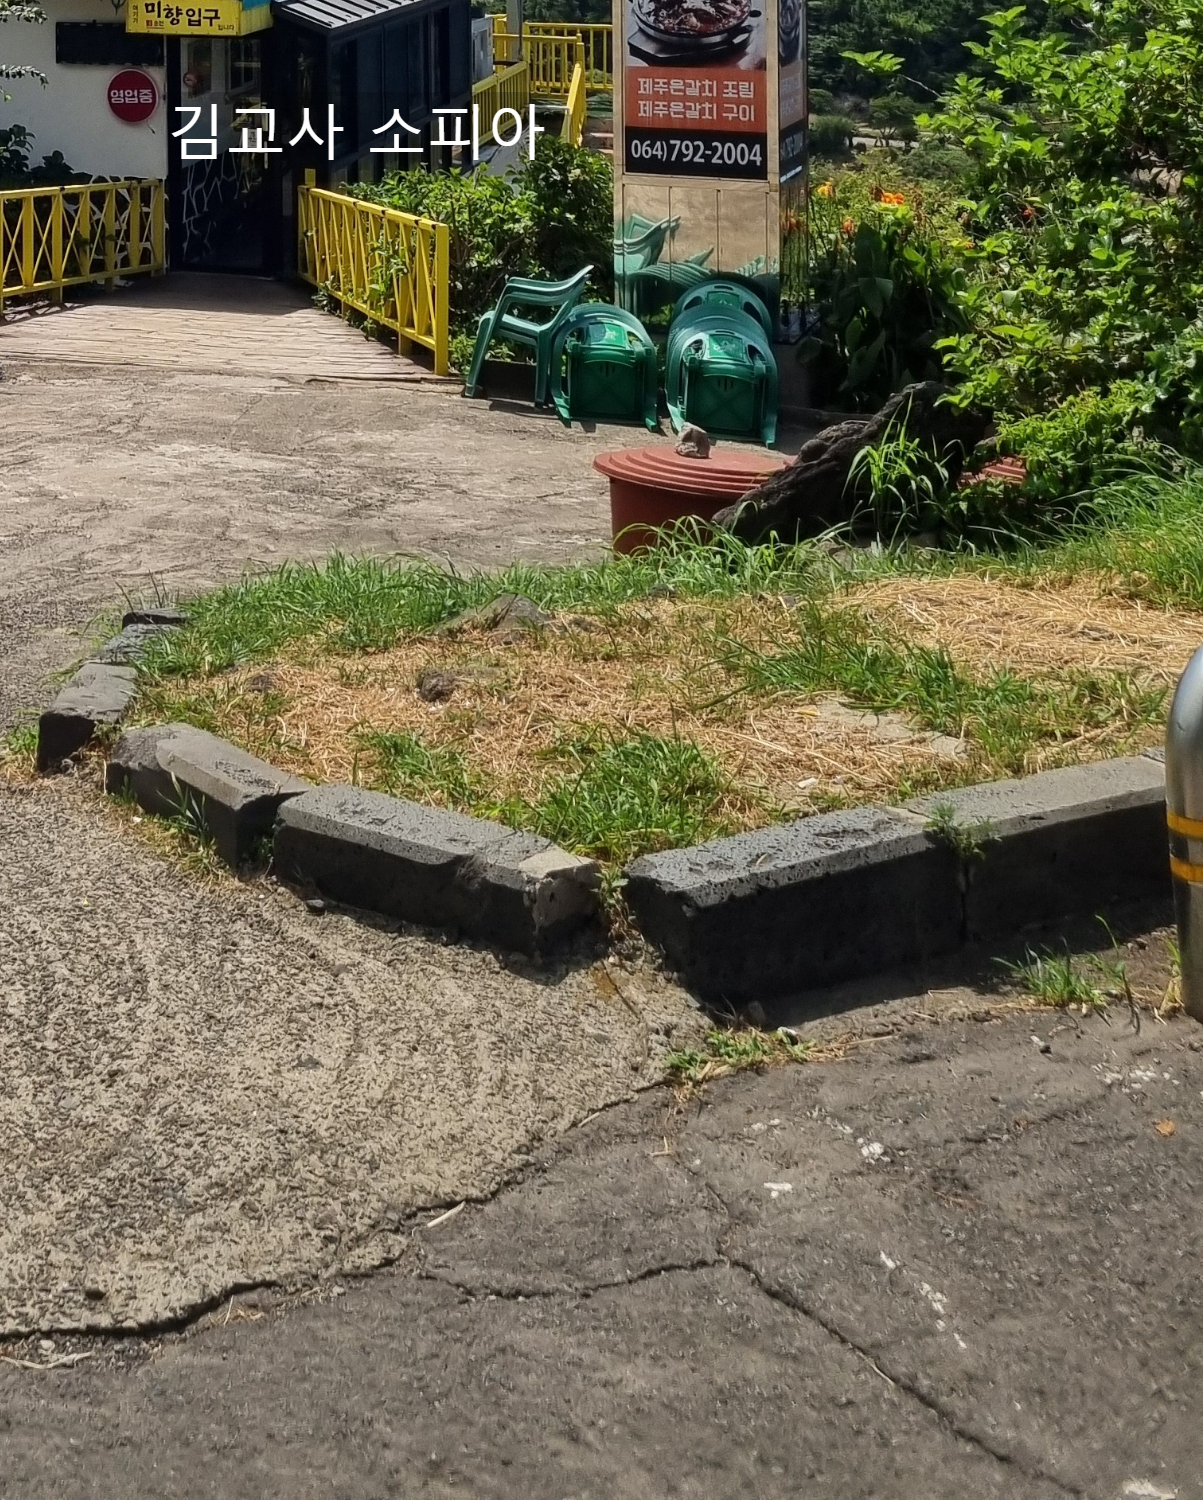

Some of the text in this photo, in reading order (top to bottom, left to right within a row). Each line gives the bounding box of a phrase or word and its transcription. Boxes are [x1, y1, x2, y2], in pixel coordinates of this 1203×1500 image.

[110, 89, 153, 104] 영업중
[637, 78, 755, 99] 제주은갈치 조림
[637, 100, 755, 122] 제주은갈치 구이
[631, 139, 763, 166] 064)792-2004
